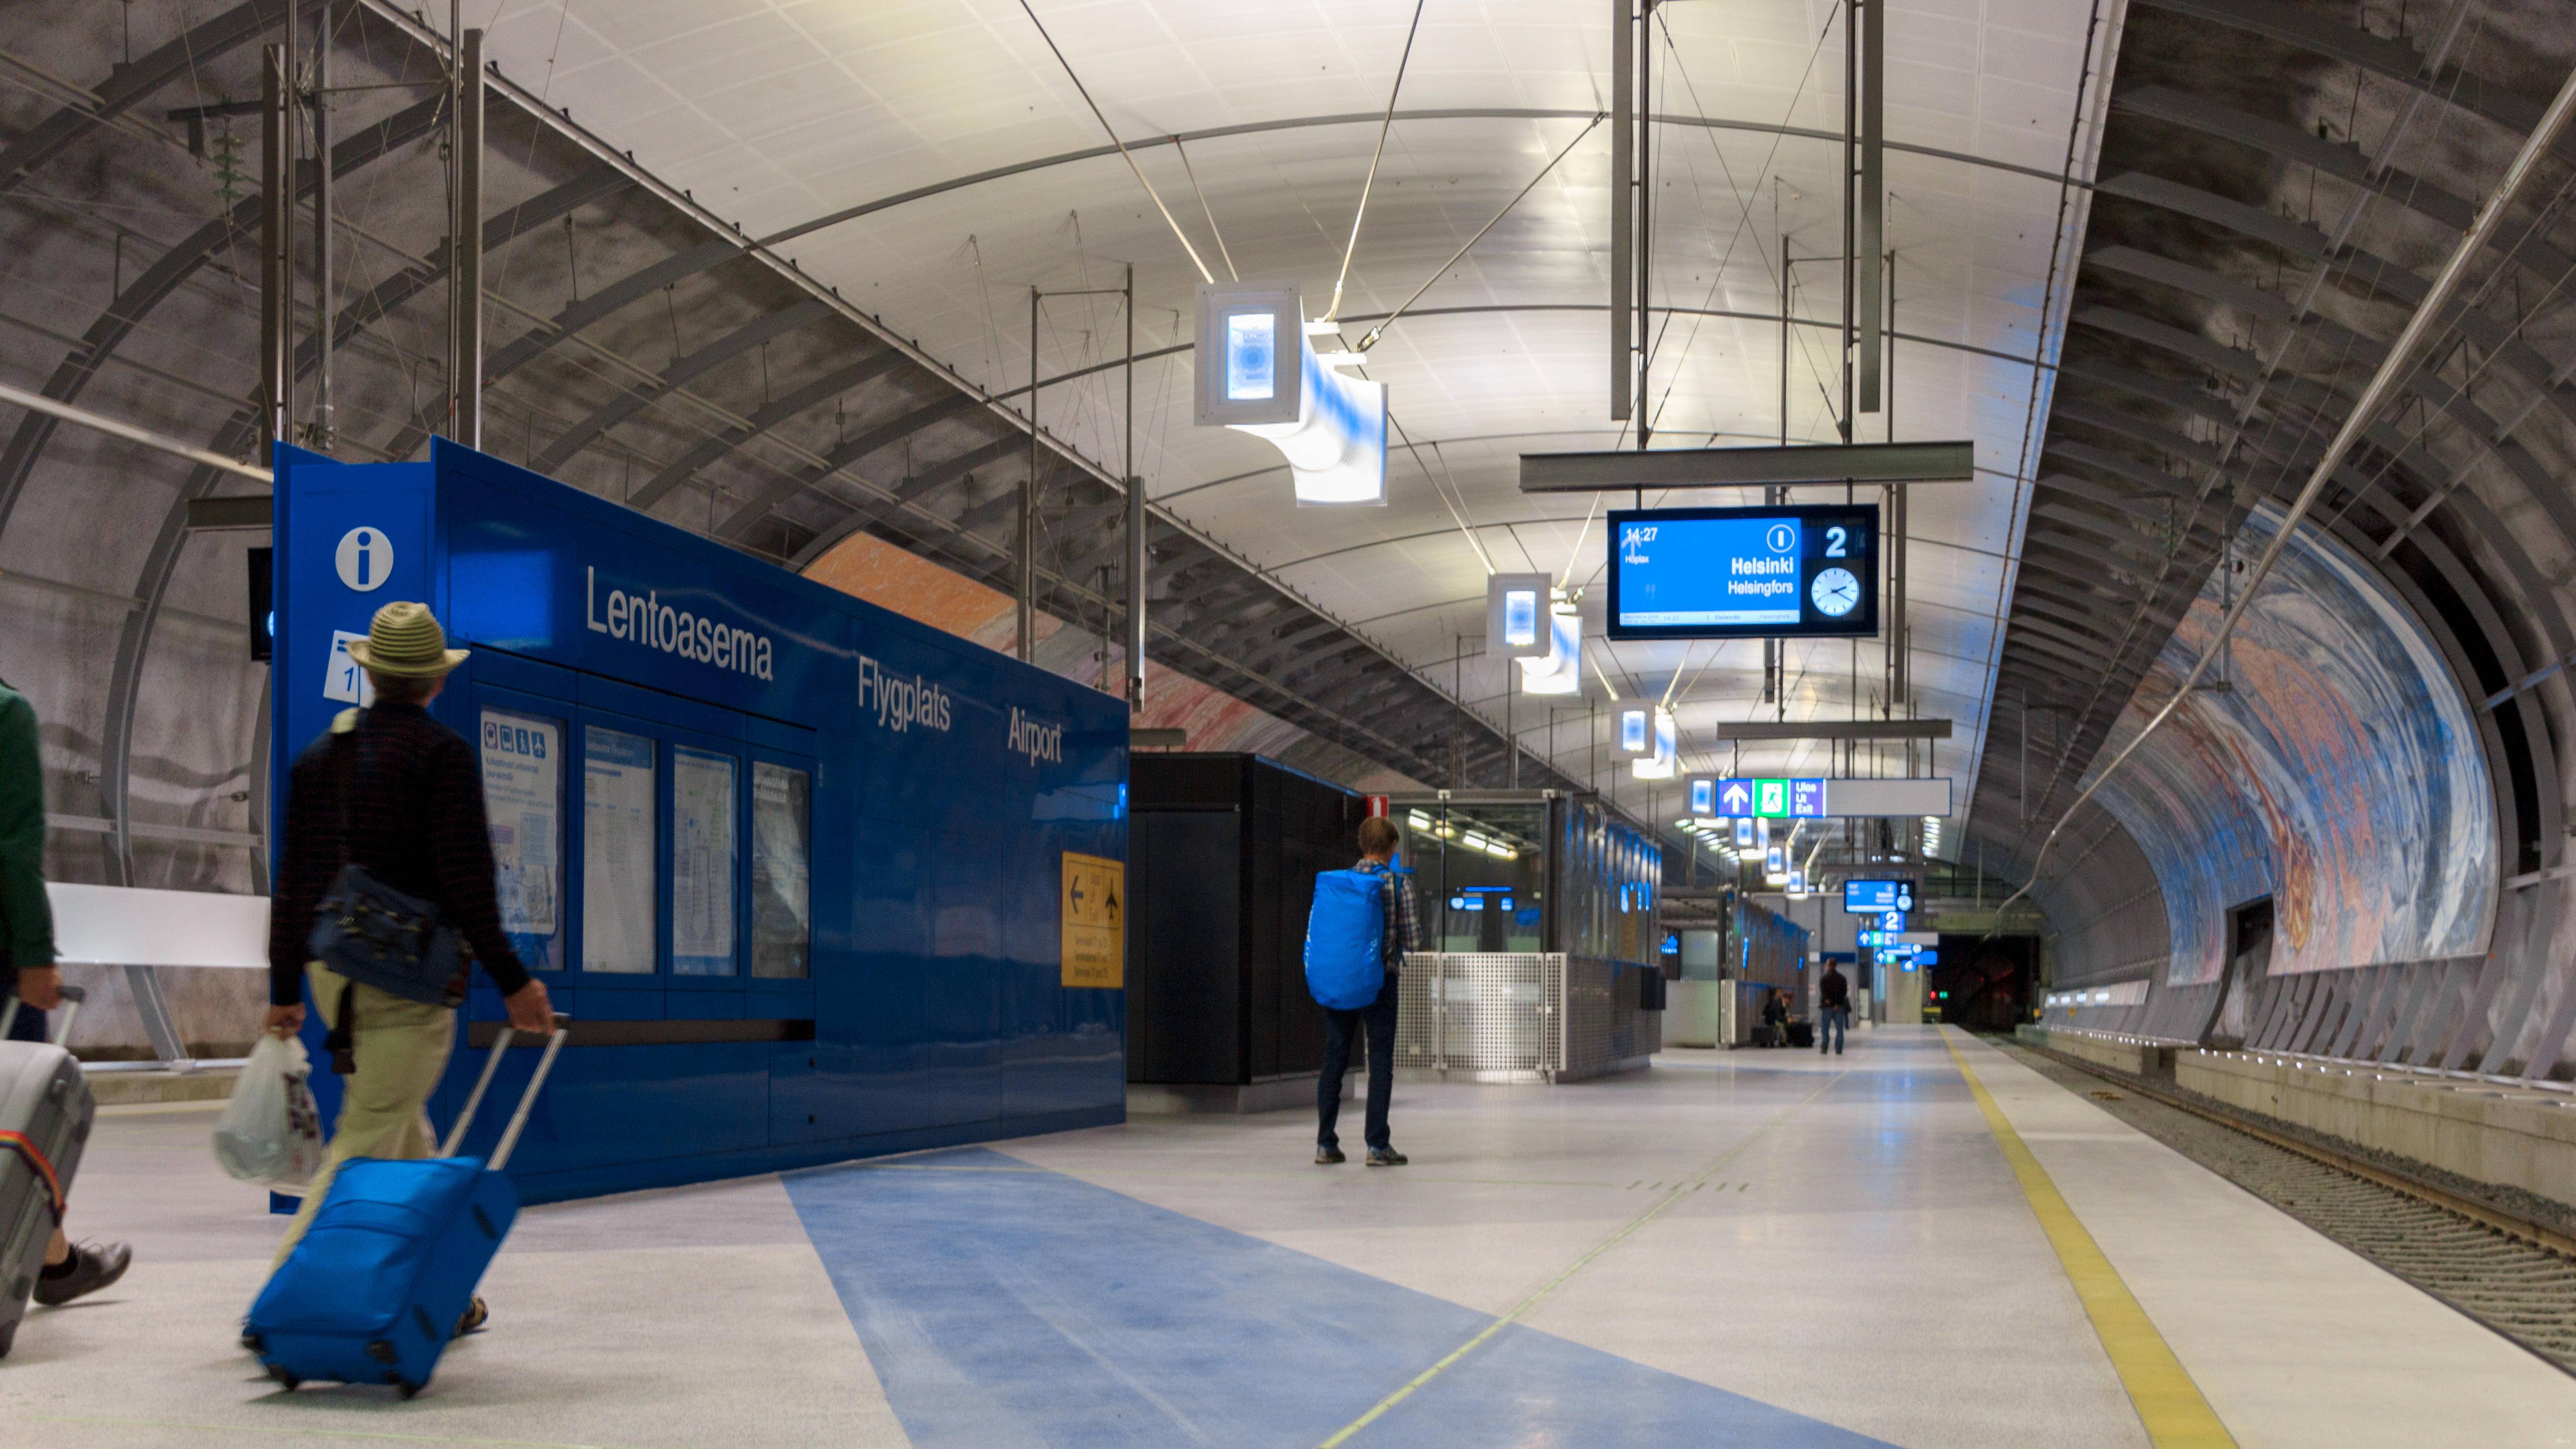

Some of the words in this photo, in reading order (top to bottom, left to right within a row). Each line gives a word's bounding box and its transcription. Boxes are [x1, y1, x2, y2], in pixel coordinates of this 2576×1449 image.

[1626, 527, 1658, 542] 14:27
[1826, 526, 1847, 558] 2
[1731, 557, 1794, 575] Helsinki
[1728, 579, 1794, 597] Helsingfors
[587, 565, 774, 682] Lentoasema
[859, 654, 951, 733] Flygplats
[1008, 706, 1062, 767] Airport
[1795, 781, 1817, 793] Ulos
[1795, 793, 1807, 804] Ut
[1795, 804, 1813, 814] Exit
[1885, 911, 1899, 931] 2
